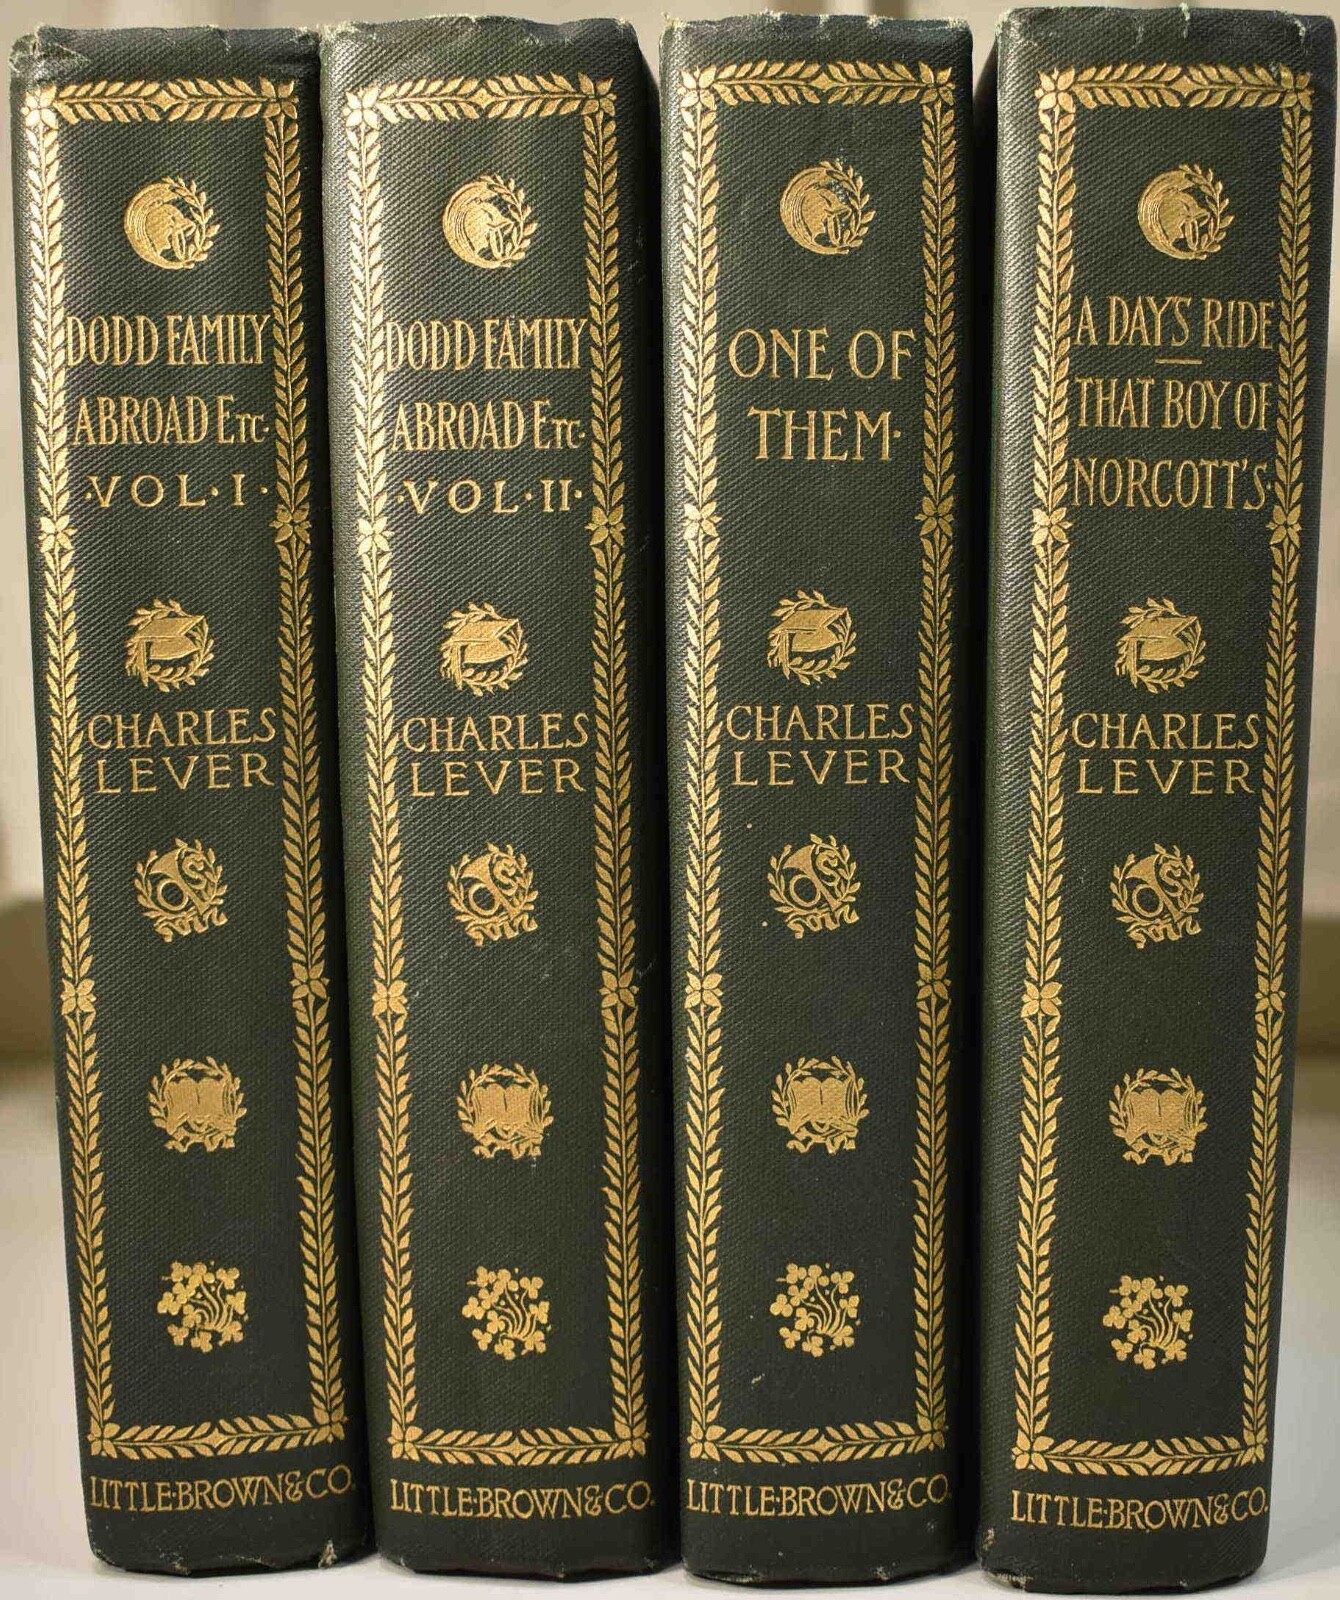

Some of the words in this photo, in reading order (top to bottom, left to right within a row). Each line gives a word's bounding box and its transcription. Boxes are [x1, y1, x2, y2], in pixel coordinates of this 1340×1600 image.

[65, 315, 159, 368] DODD
[167, 313, 272, 367] FAMILY
[385, 319, 477, 373] DODD
[485, 316, 588, 371] FAMILY
[1072, 297, 1097, 347] A
[1202, 299, 1276, 350] RIDE
[729, 328, 834, 380] ONE
[849, 328, 916, 380] OF
[74, 395, 209, 446] ABROAD
[1075, 377, 1155, 429] THAT
[1162, 380, 1228, 431] BOY
[1234, 380, 1274, 431] OF
[392, 401, 526, 452] ABROAD
[88, 707, 277, 750] CHARLES
[402, 712, 590, 753] CHARLES
[726, 702, 915, 742] CHARLES
[1072, 712, 1265, 750] CHARLES
[96, 753, 275, 794] LEVER
[409, 757, 586, 797] LEVER
[734, 747, 910, 786] LEVER
[1077, 757, 1255, 795] LEVER
